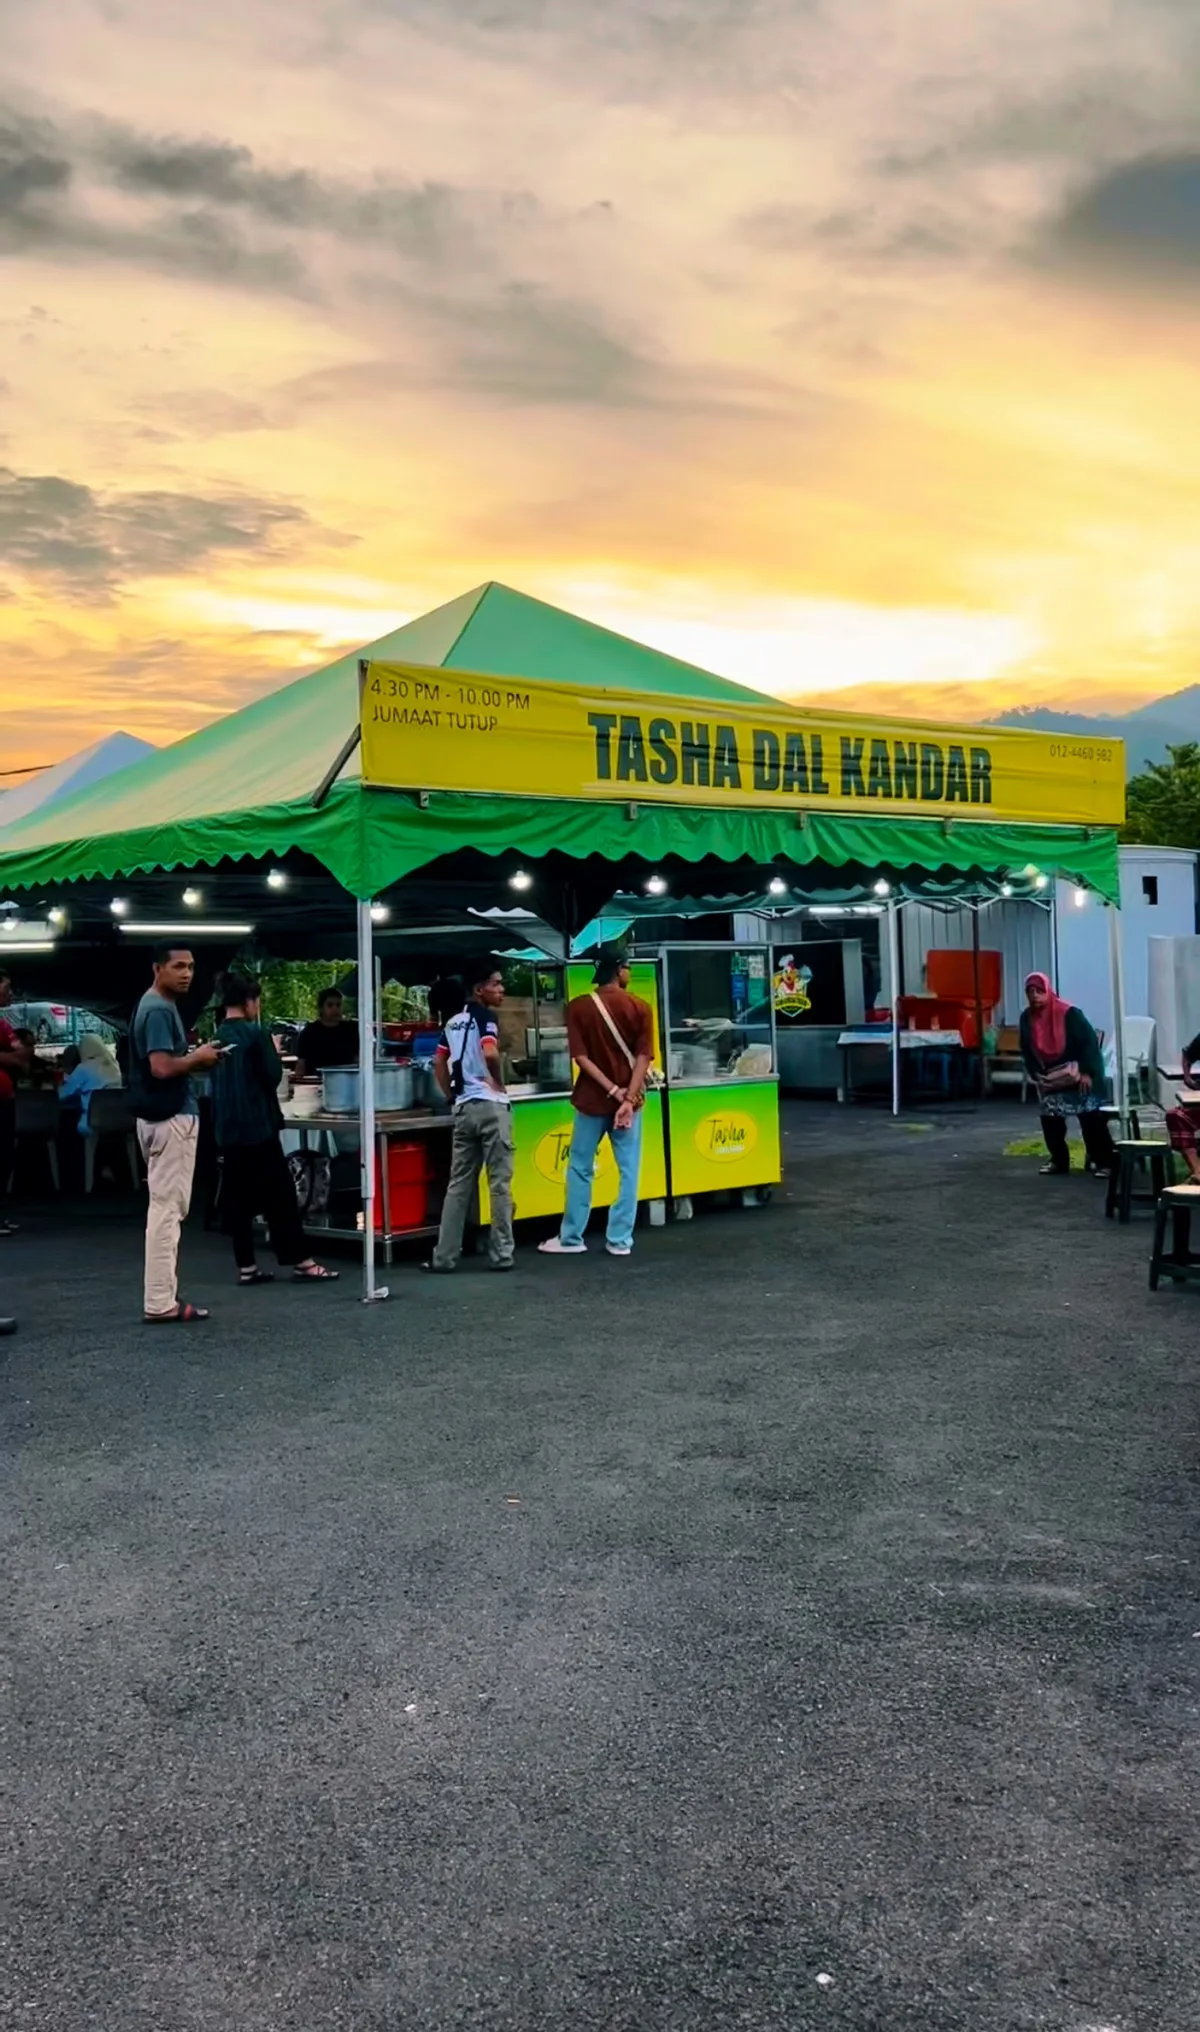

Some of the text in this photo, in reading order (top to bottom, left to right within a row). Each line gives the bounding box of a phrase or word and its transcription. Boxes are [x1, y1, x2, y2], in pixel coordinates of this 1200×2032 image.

[371, 679, 408, 698] 4.30
[415, 682, 439, 700] PM
[459, 688, 500, 708] 10.00
[507, 692, 530, 709] PM
[373, 705, 497, 731] JUMAAT TUTUP
[588, 712, 992, 803] TASHA DAL KANDAR
[707, 1119, 747, 1149] Tasha
